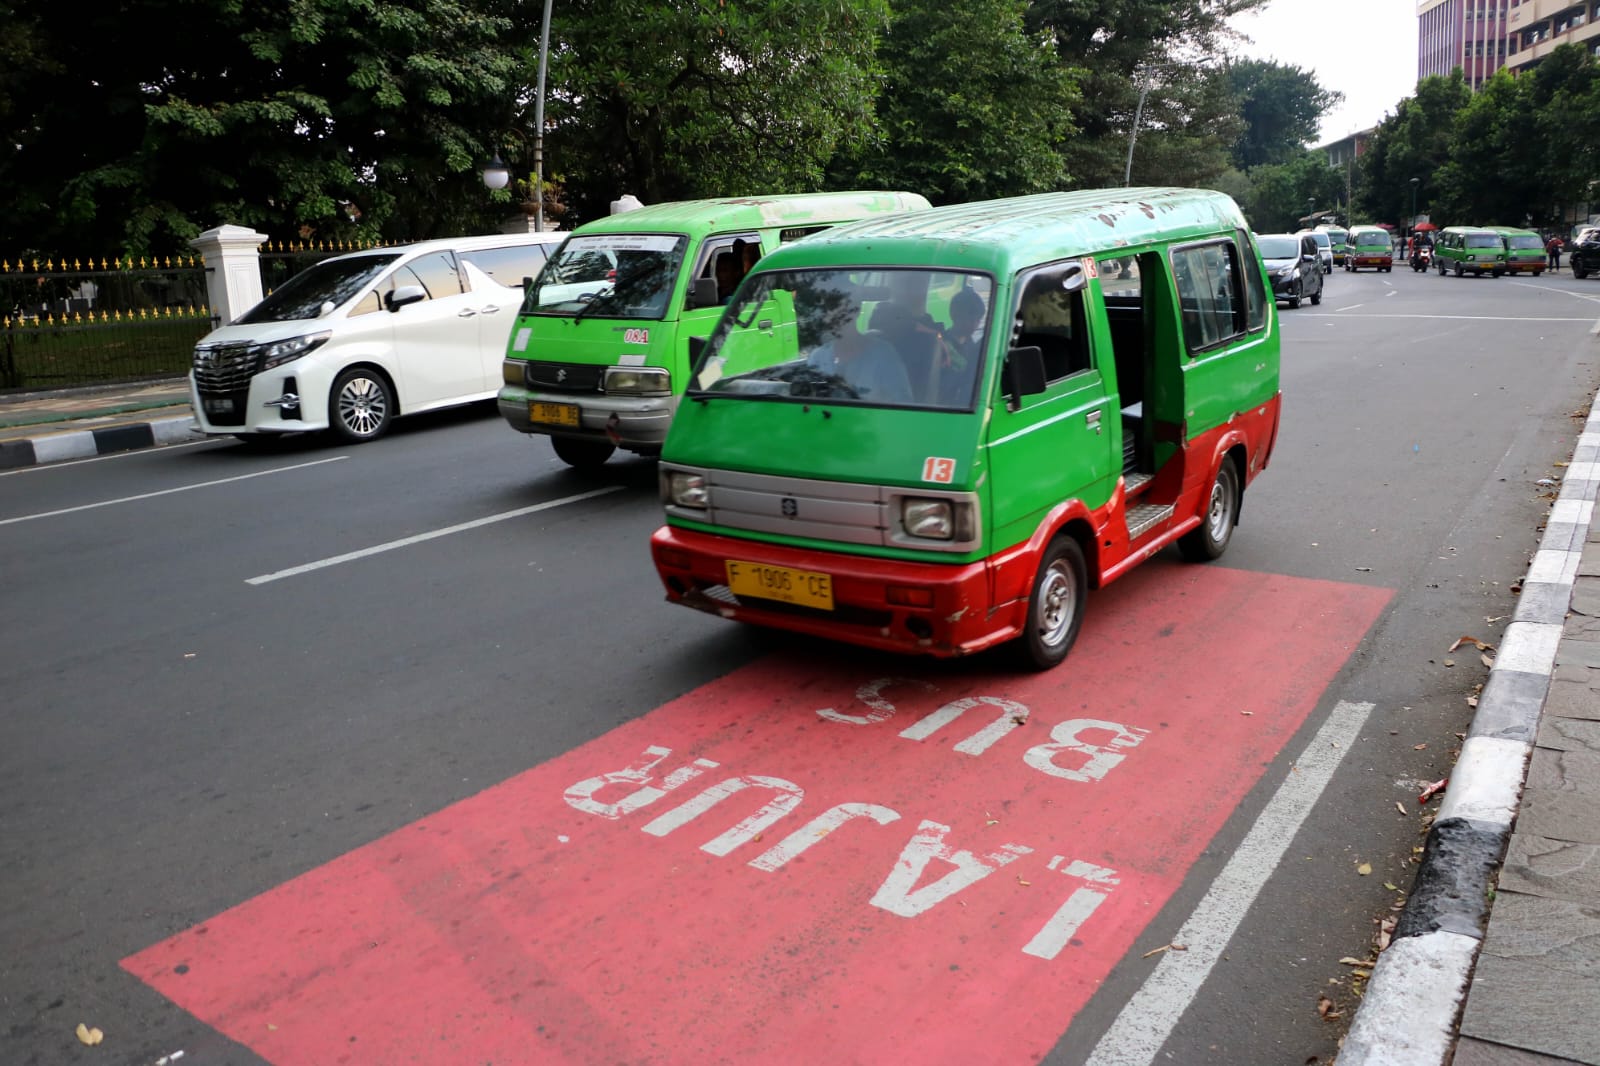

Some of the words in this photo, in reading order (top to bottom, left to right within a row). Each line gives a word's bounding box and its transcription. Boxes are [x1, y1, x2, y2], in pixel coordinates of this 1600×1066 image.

[1082, 257, 1098, 278] 13
[924, 457, 954, 482] 13
[729, 563, 739, 583] F
[753, 567, 792, 591] 1906
[807, 576, 829, 598] CE
[816, 678, 1152, 783] BUS
[563, 745, 1120, 960] LAJUR
